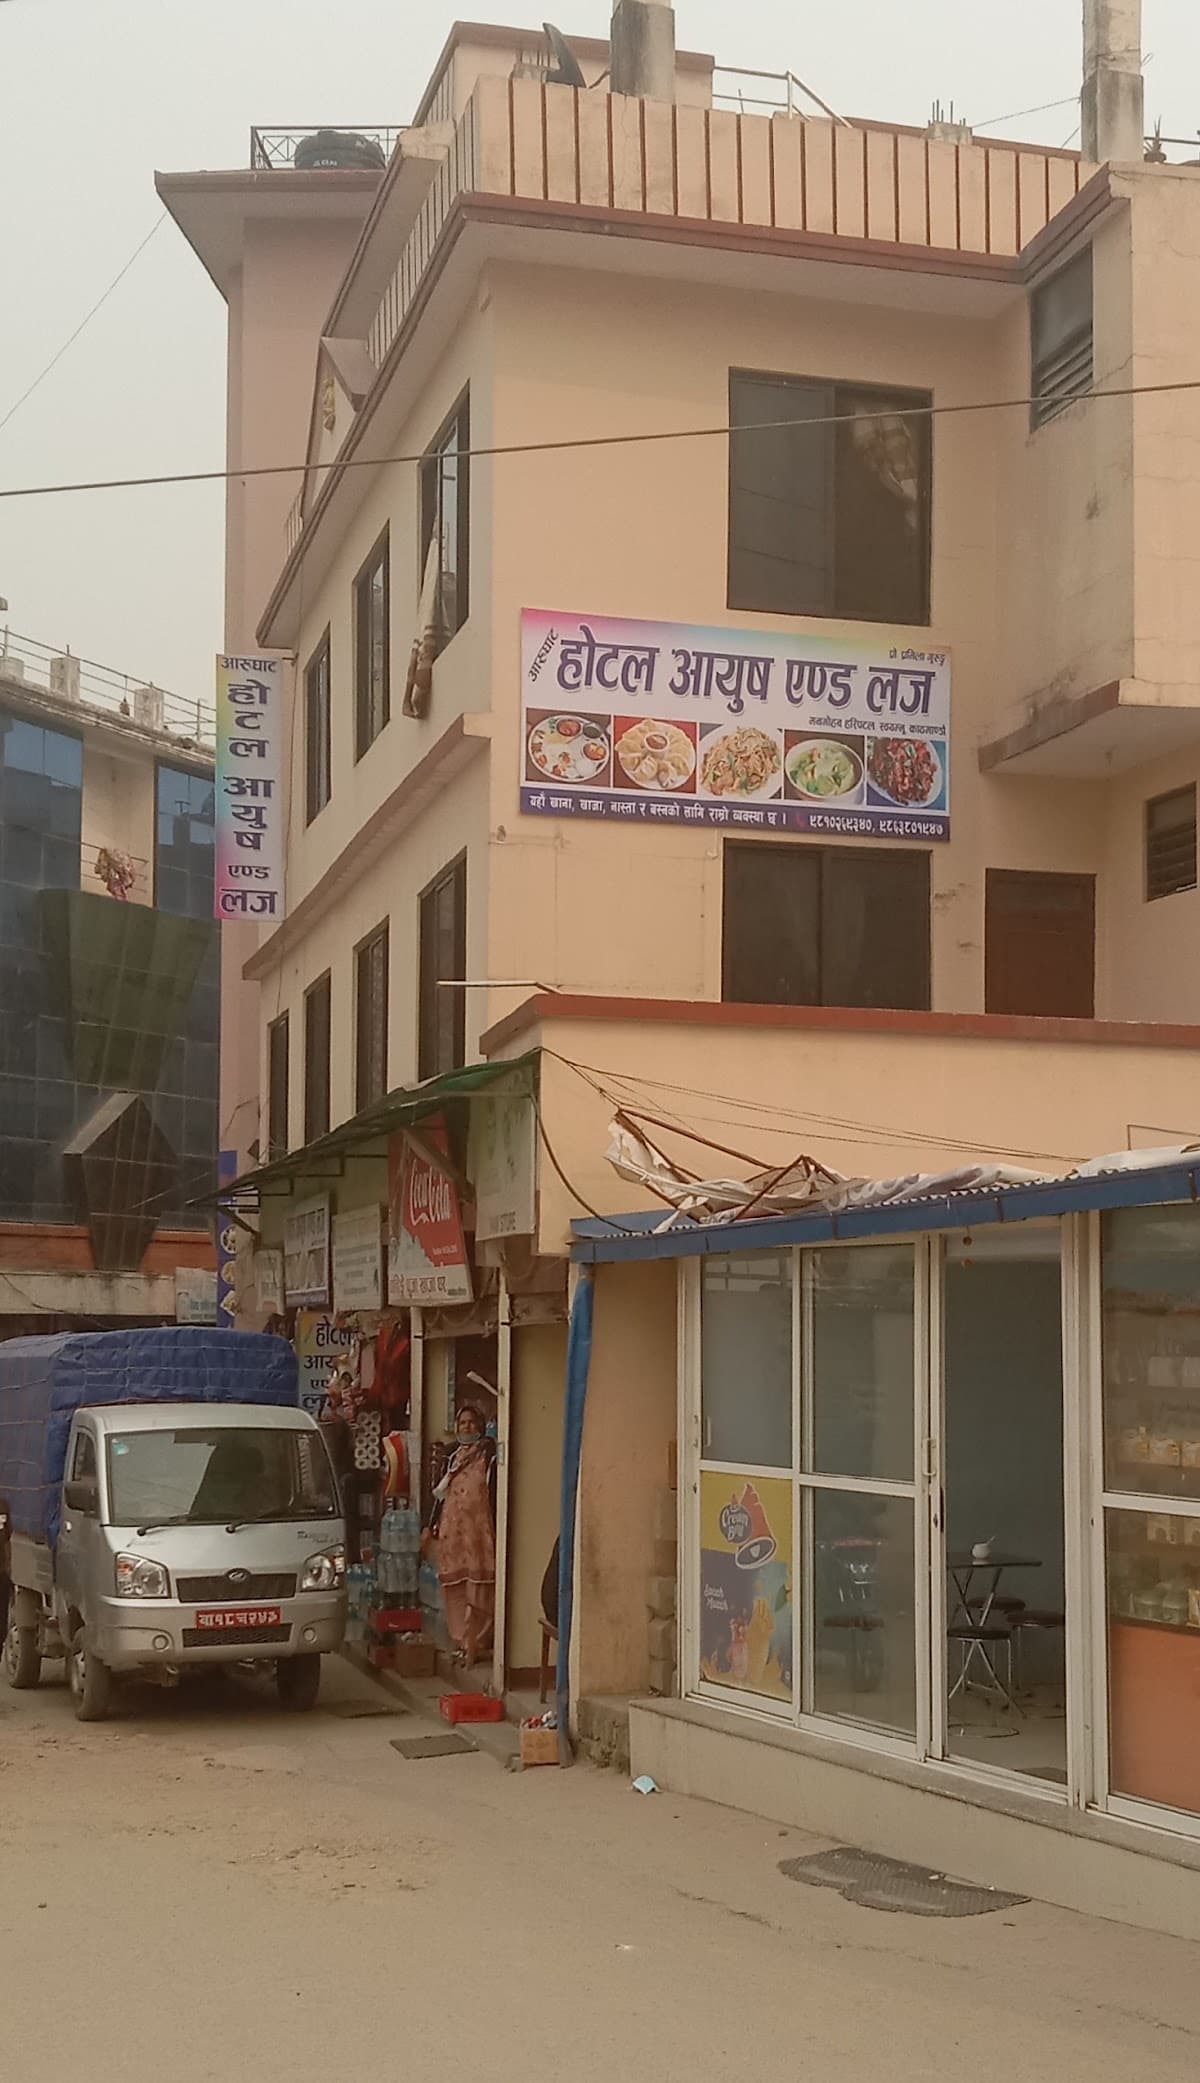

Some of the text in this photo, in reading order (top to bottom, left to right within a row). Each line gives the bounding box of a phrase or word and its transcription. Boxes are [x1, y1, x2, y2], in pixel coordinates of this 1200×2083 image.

[557, 624, 936, 713] होटल आयुष एण्ड लज
[228, 865, 270, 879] एण्ड
[220, 889, 278, 914] लज
